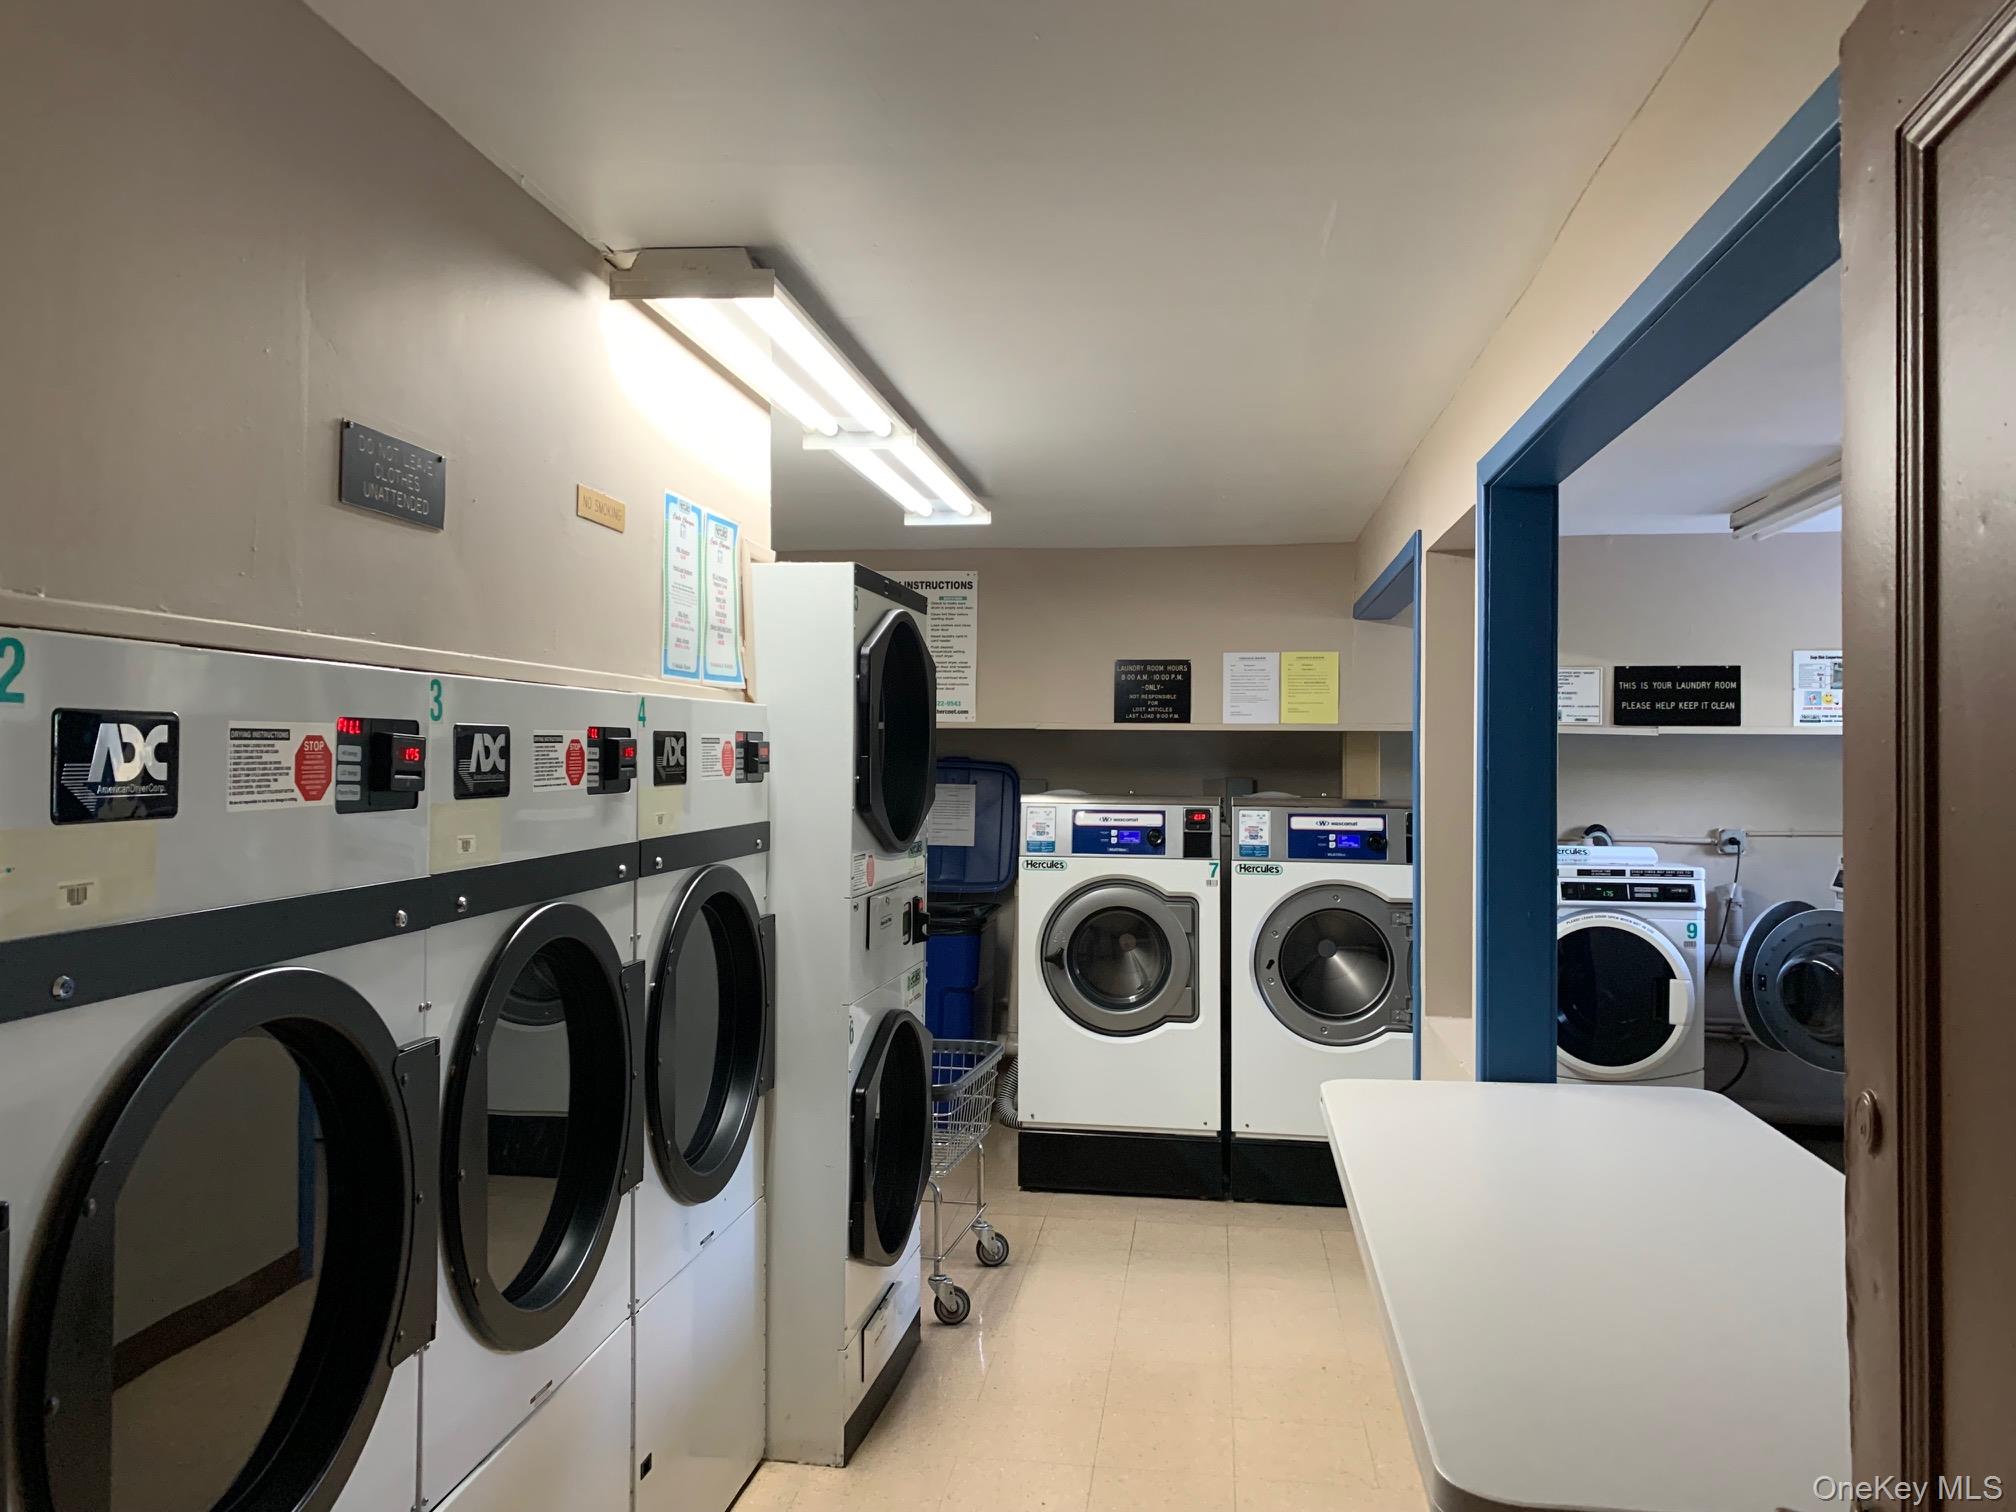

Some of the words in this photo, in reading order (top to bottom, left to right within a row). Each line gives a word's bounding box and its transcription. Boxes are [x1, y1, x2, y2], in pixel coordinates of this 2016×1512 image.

[359, 434, 374, 454] DO
[378, 442, 400, 463] NOT
[375, 462, 420, 491] CLOTHES
[363, 480, 429, 515] UNATTENDED
[583, 495, 592, 510] NO
[594, 499, 622, 521] SMOKING
[904, 580, 974, 590] INSTRUCTIONS
[0, 637, 25, 703] 2
[1618, 681, 1637, 690] THIS
[1640, 681, 1649, 690] IS
[1652, 681, 1672, 690] YOUR
[1675, 681, 1712, 690] LAUNDRY
[1713, 681, 1737, 690] ROOM
[430, 679, 443, 721] 3
[1621, 701, 1651, 710] PLEASE
[1655, 701, 1676, 710] HELP
[1678, 701, 1699, 710] KEEP
[1700, 701, 1709, 710] IT
[1710, 701, 1736, 710] CLEAN
[637, 696, 647, 727] 4
[252, 730, 289, 739] INSTRUCTIONS
[88, 722, 168, 782] ADC
[304, 740, 325, 751] STOP
[469, 732, 506, 773] ADC
[569, 742, 581, 750] STOP
[662, 736, 685, 767] ADC
[1557, 848, 1588, 857] ercules
[1025, 859, 1064, 870] Hercules
[1208, 862, 1219, 878] 7
[1239, 863, 1281, 874] Hercules
[1686, 922, 1698, 940] 9
